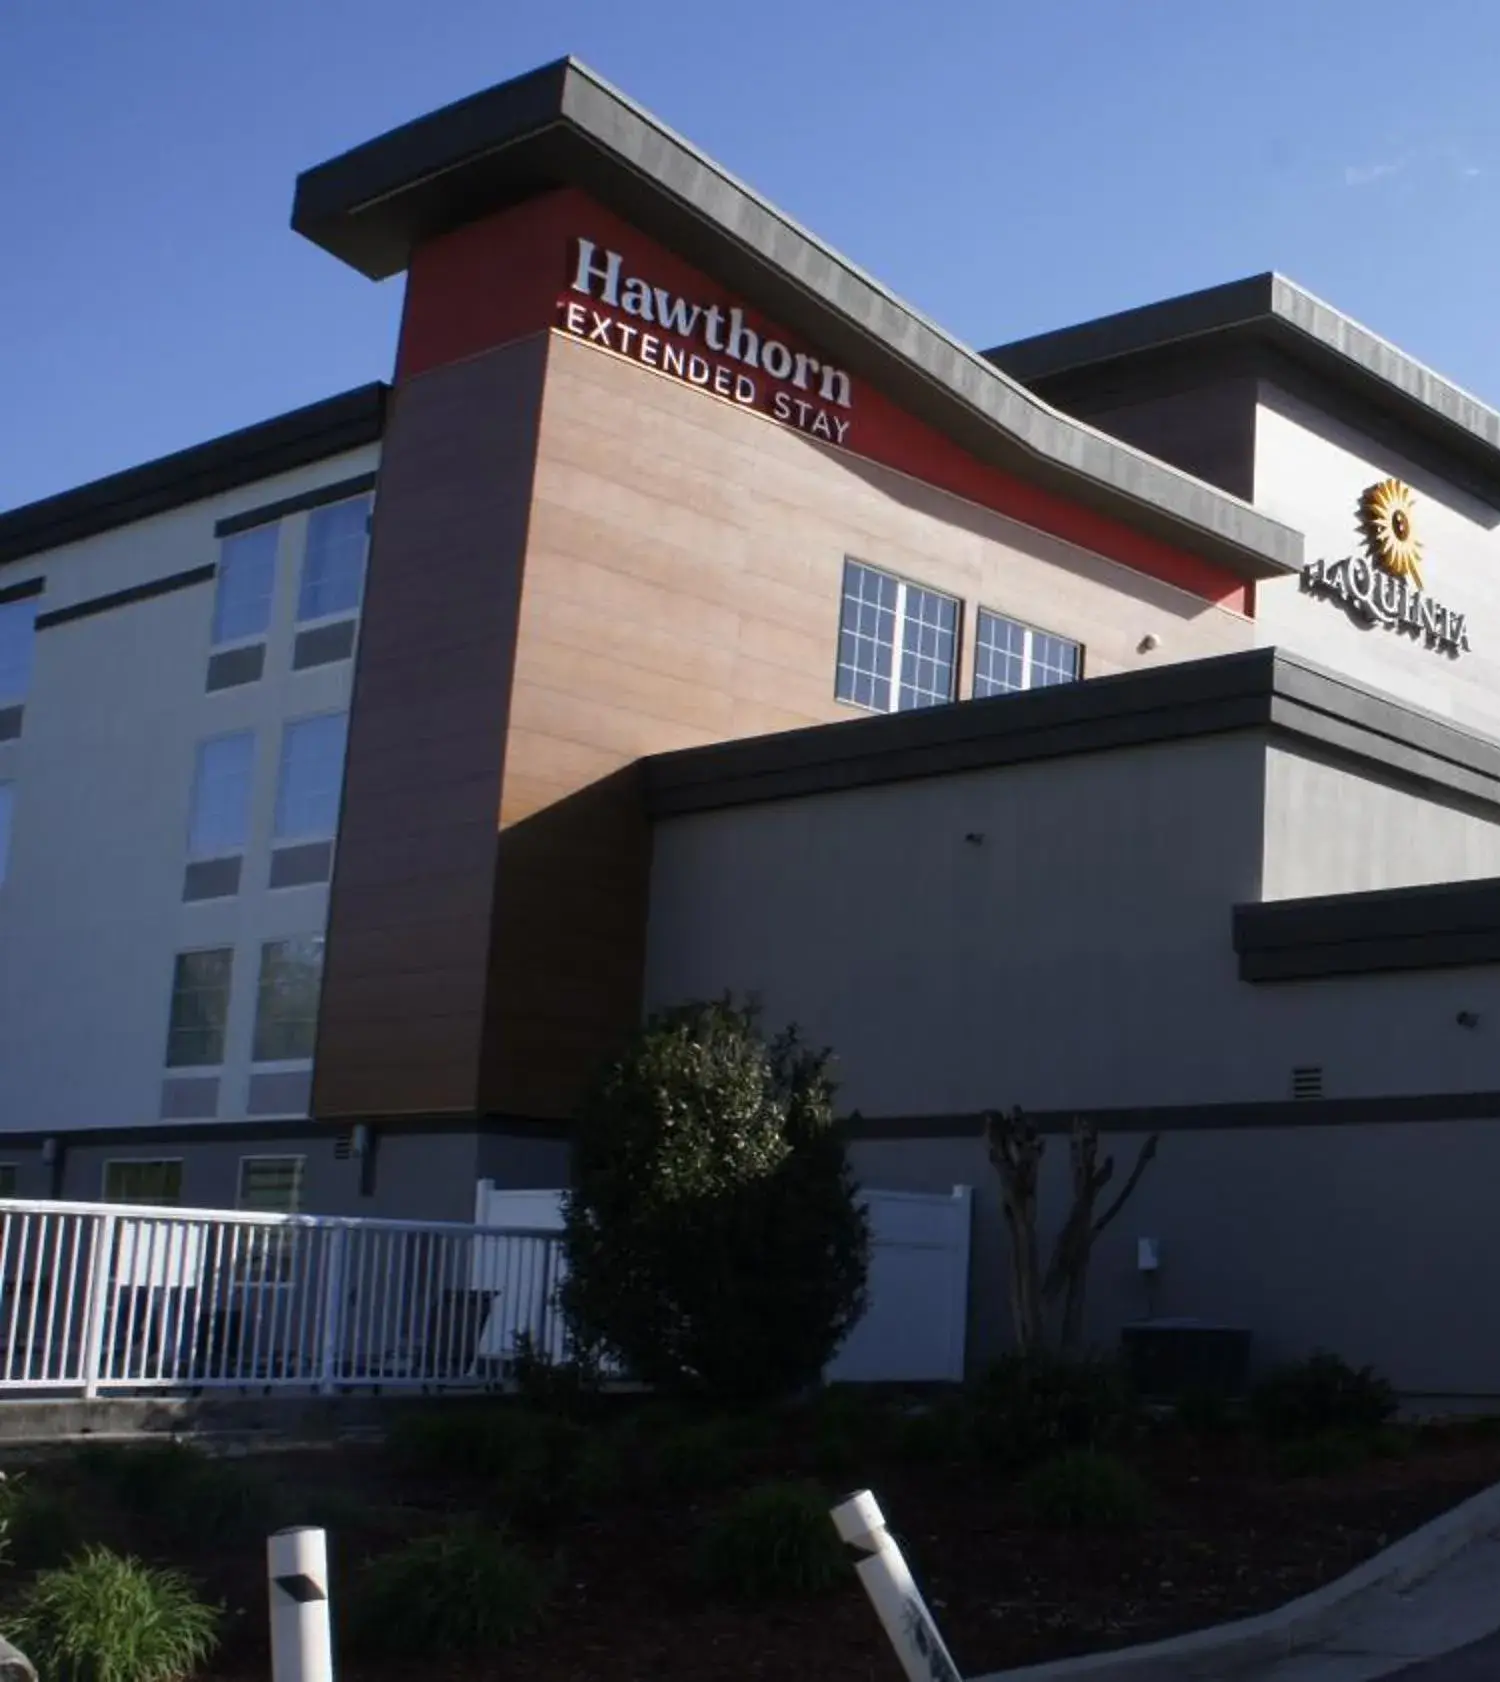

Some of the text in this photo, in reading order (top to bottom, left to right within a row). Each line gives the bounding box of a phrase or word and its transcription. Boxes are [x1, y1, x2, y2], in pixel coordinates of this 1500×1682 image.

[566, 303, 851, 444] EXTENDED STAY
[571, 237, 852, 408] Hawthorn
